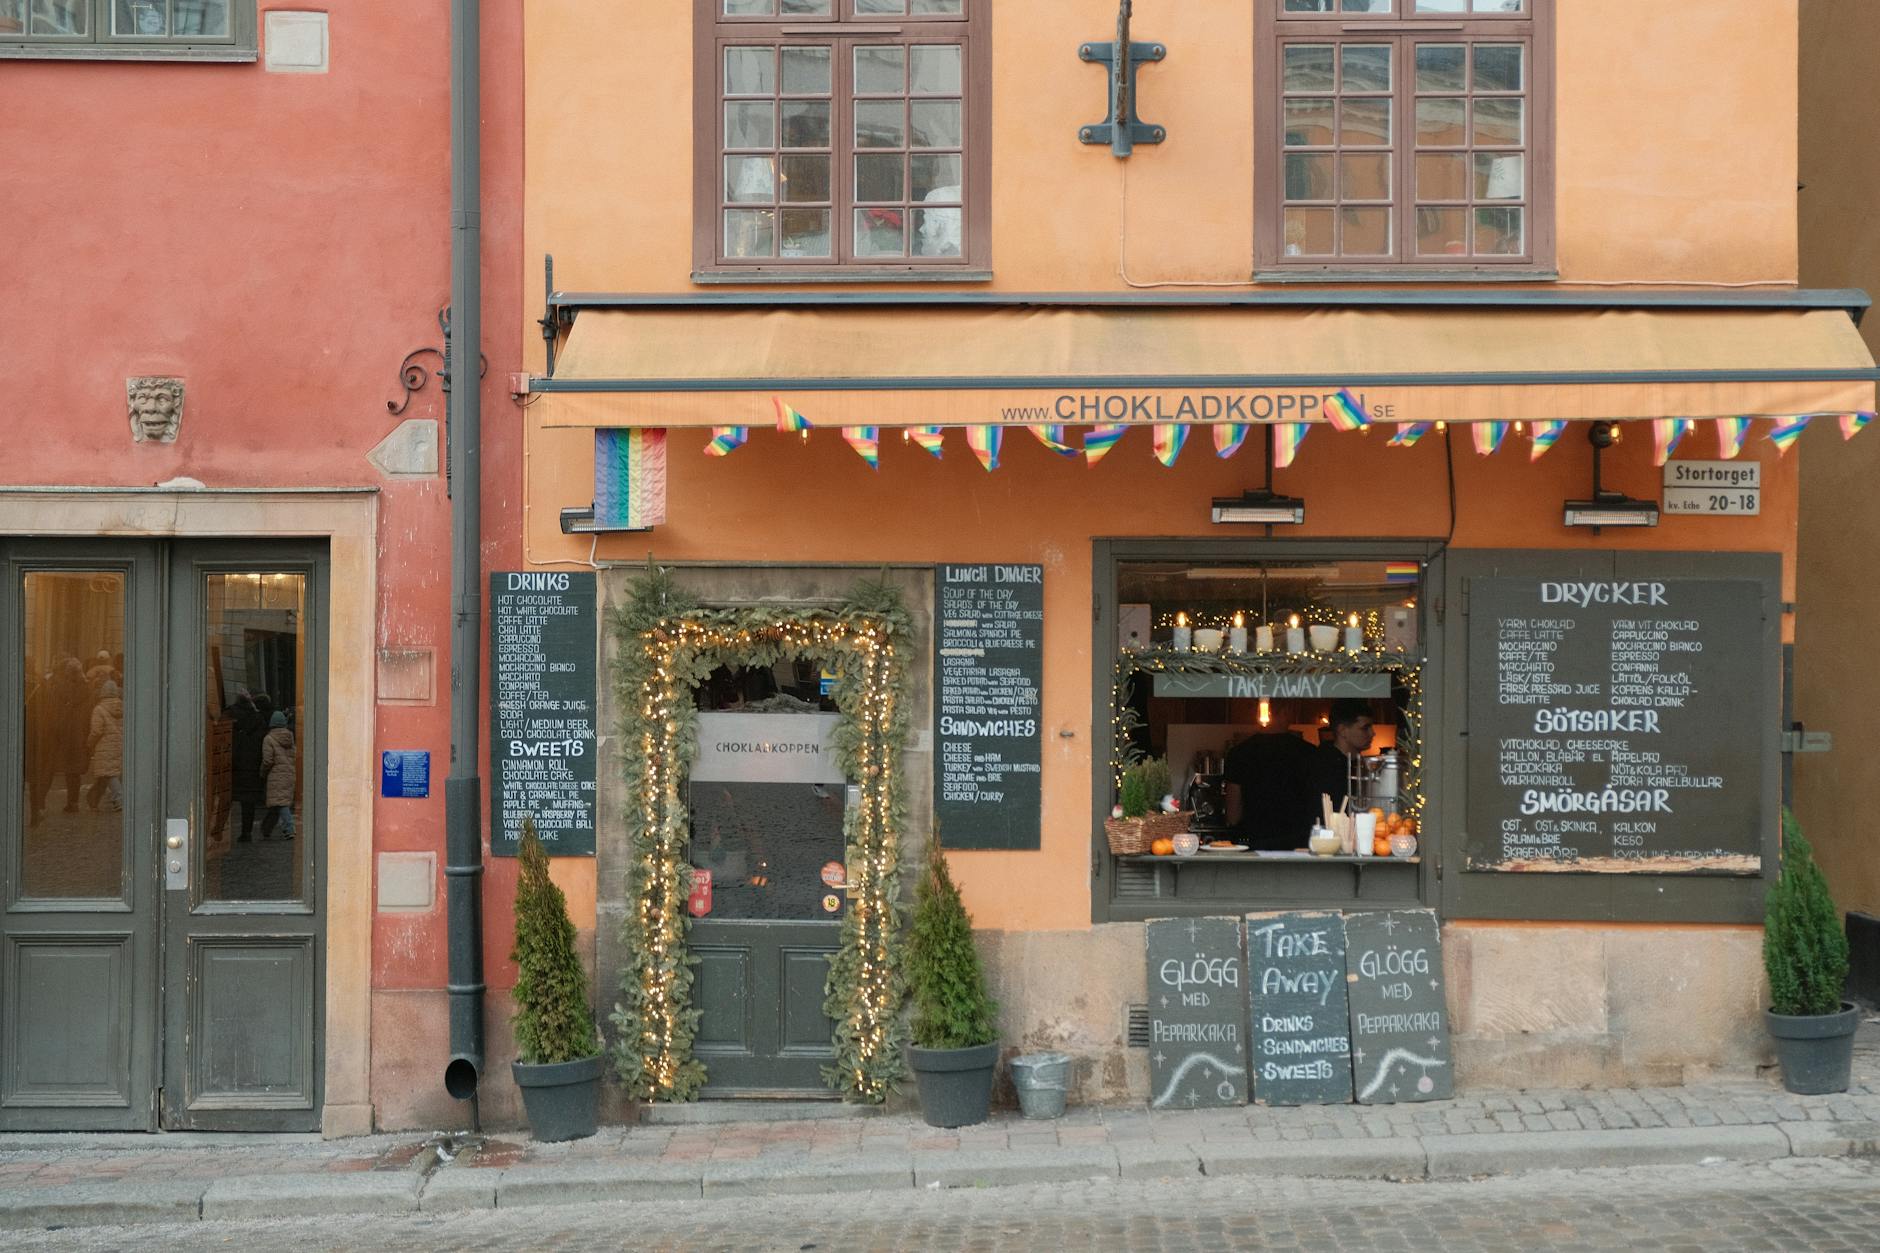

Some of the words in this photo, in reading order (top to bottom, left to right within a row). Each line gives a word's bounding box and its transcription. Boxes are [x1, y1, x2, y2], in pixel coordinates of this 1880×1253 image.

[1676, 465, 1754, 485] Stortorget
[1709, 495, 1755, 510] 20-18
[946, 566, 987, 582] LUNCH
[995, 566, 1042, 583] DINNER
[508, 573, 569, 591] DRINKS
[943, 587, 964, 599] SOUP
[967, 590, 976, 598] OF
[979, 589, 994, 599] THE
[997, 590, 1013, 600] DAY
[1540, 581, 1669, 608] DRYCKER
[498, 596, 514, 605] HOT
[517, 596, 562, 605] CHOCOLATE
[517, 607, 536, 615] WHITE
[540, 606, 578, 615] CHOCOLATE
[1006, 602, 1018, 610] DAY
[944, 610, 956, 618] VEG
[959, 610, 981, 618] SALAD
[498, 616, 522, 624] CAFFE
[526, 616, 547, 624] LATTE
[1499, 619, 1526, 628] VARM
[1531, 619, 1575, 629] CHOKLAD
[499, 626, 516, 634] CHAI
[520, 626, 541, 634] LATTE
[1656, 621, 1699, 630] CHOKLAD
[979, 630, 1007, 638] SPINACH
[1011, 630, 1021, 638] PIE
[1499, 630, 1530, 639] CAFFE
[1535, 631, 1564, 639] LATTE
[1612, 632, 1668, 640] CAPPUCCINO
[499, 635, 541, 643] CAPPUCCINO
[944, 639, 977, 647] BROCCOLI
[1026, 640, 1035, 648] PIE
[499, 644, 539, 653] ESPRESSO
[1499, 642, 1557, 651] MOCHACCINO
[1612, 642, 1667, 651] MOCHACCINO
[1670, 642, 1702, 651] BIANCO
[499, 654, 545, 662] MOCHACCINO
[1612, 652, 1659, 661] ESPRESSO
[499, 664, 545, 672] MOCHACCINO
[550, 664, 575, 672] BIANCO
[1499, 662, 1555, 671] MACCHIATO
[1611, 663, 1659, 672] CONPANNA
[943, 668, 986, 676] VEGETARIAN
[499, 673, 540, 681] MACCHIATO
[499, 682, 540, 690] CONPANNA
[1222, 675, 1267, 697] TAKE
[1272, 675, 1326, 697] AWAY
[1576, 684, 1600, 694] JUICE
[1612, 686, 1653, 695] KOPPENS
[943, 696, 963, 704] PASTA
[1611, 697, 1652, 706] CHOKLAD
[1655, 698, 1685, 707] DRINK
[530, 701, 560, 710] ORANGE
[500, 710, 523, 719] SODA
[943, 706, 964, 714] PASTA
[966, 706, 986, 714] SALAD
[1010, 707, 1031, 715] PESTO
[567, 720, 588, 729] BEER
[1534, 706, 1661, 734] SÖTSAKER
[940, 717, 1035, 737] SANDWICHES
[501, 730, 523, 738] COLD
[527, 730, 570, 739] CHOCOLATE
[574, 730, 595, 739] DRINK
[510, 739, 584, 756] SWEETS
[943, 743, 971, 752] CHEESE
[944, 753, 971, 762] CHEESE
[985, 753, 1001, 762] HAM
[1611, 751, 1660, 763] ÄPPELPAJ
[502, 760, 544, 770] CINNAMON
[549, 760, 568, 771] ROLL
[944, 764, 971, 772] TURKEY
[985, 764, 1012, 772] SWEDISH
[1501, 763, 1562, 773] KLADDKAKA
[503, 771, 548, 780] CHOCOLATE
[551, 771, 573, 780] CAKE
[988, 774, 1002, 782] BRIE
[1501, 775, 1576, 786] VALRHONABOLL
[1611, 776, 1643, 786] STORA
[1648, 777, 1723, 788] KANELBULLAR
[944, 783, 978, 791] SEAFOOD
[503, 791, 517, 799] NUT
[569, 791, 579, 799] PIE
[1520, 785, 1673, 815] SMÖRGÅSAR
[553, 801, 584, 809] MUFFINS
[577, 810, 587, 819] PIE
[576, 820, 593, 829] BALL
[1614, 822, 1656, 833] KALKON
[539, 831, 559, 840] CAKE
[1614, 836, 1643, 846] KESO
[1255, 923, 1328, 957] TAKE
[1361, 946, 1429, 979] GLÖGG
[1160, 953, 1238, 991] GLÖGG
[1262, 968, 1338, 1005] AWAY
[1382, 983, 1413, 1000] MED
[1183, 993, 1210, 1007] MED
[1263, 1016, 1313, 1032] DRINKS
[1358, 1012, 1440, 1035] PEPPARKAKA
[1154, 1020, 1237, 1042] PEPPARKAKA
[1263, 1037, 1348, 1053] SANDWICHES
[1264, 1060, 1333, 1080] SWEETS
